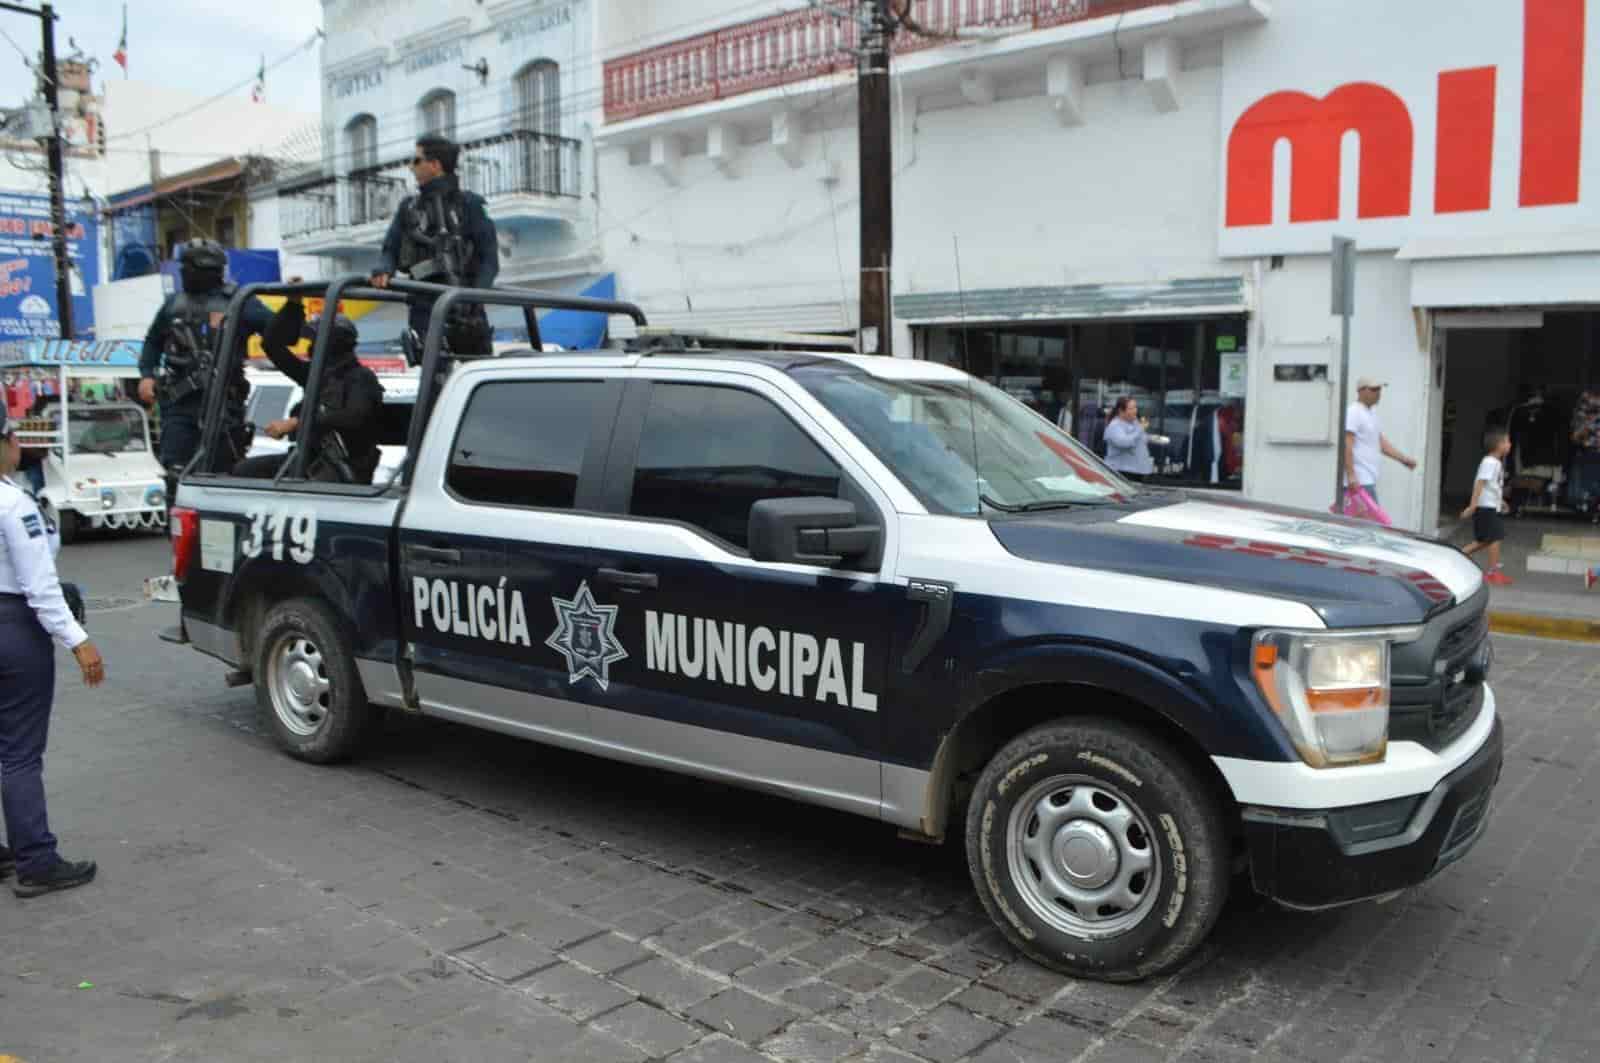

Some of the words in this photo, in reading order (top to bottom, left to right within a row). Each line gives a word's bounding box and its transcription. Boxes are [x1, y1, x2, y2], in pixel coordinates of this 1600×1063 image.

[1225, 0, 1586, 228] mil
[242, 506, 317, 564] 319
[412, 576, 532, 647] POLICÍA
[645, 610, 878, 713] MUNICIPAL
